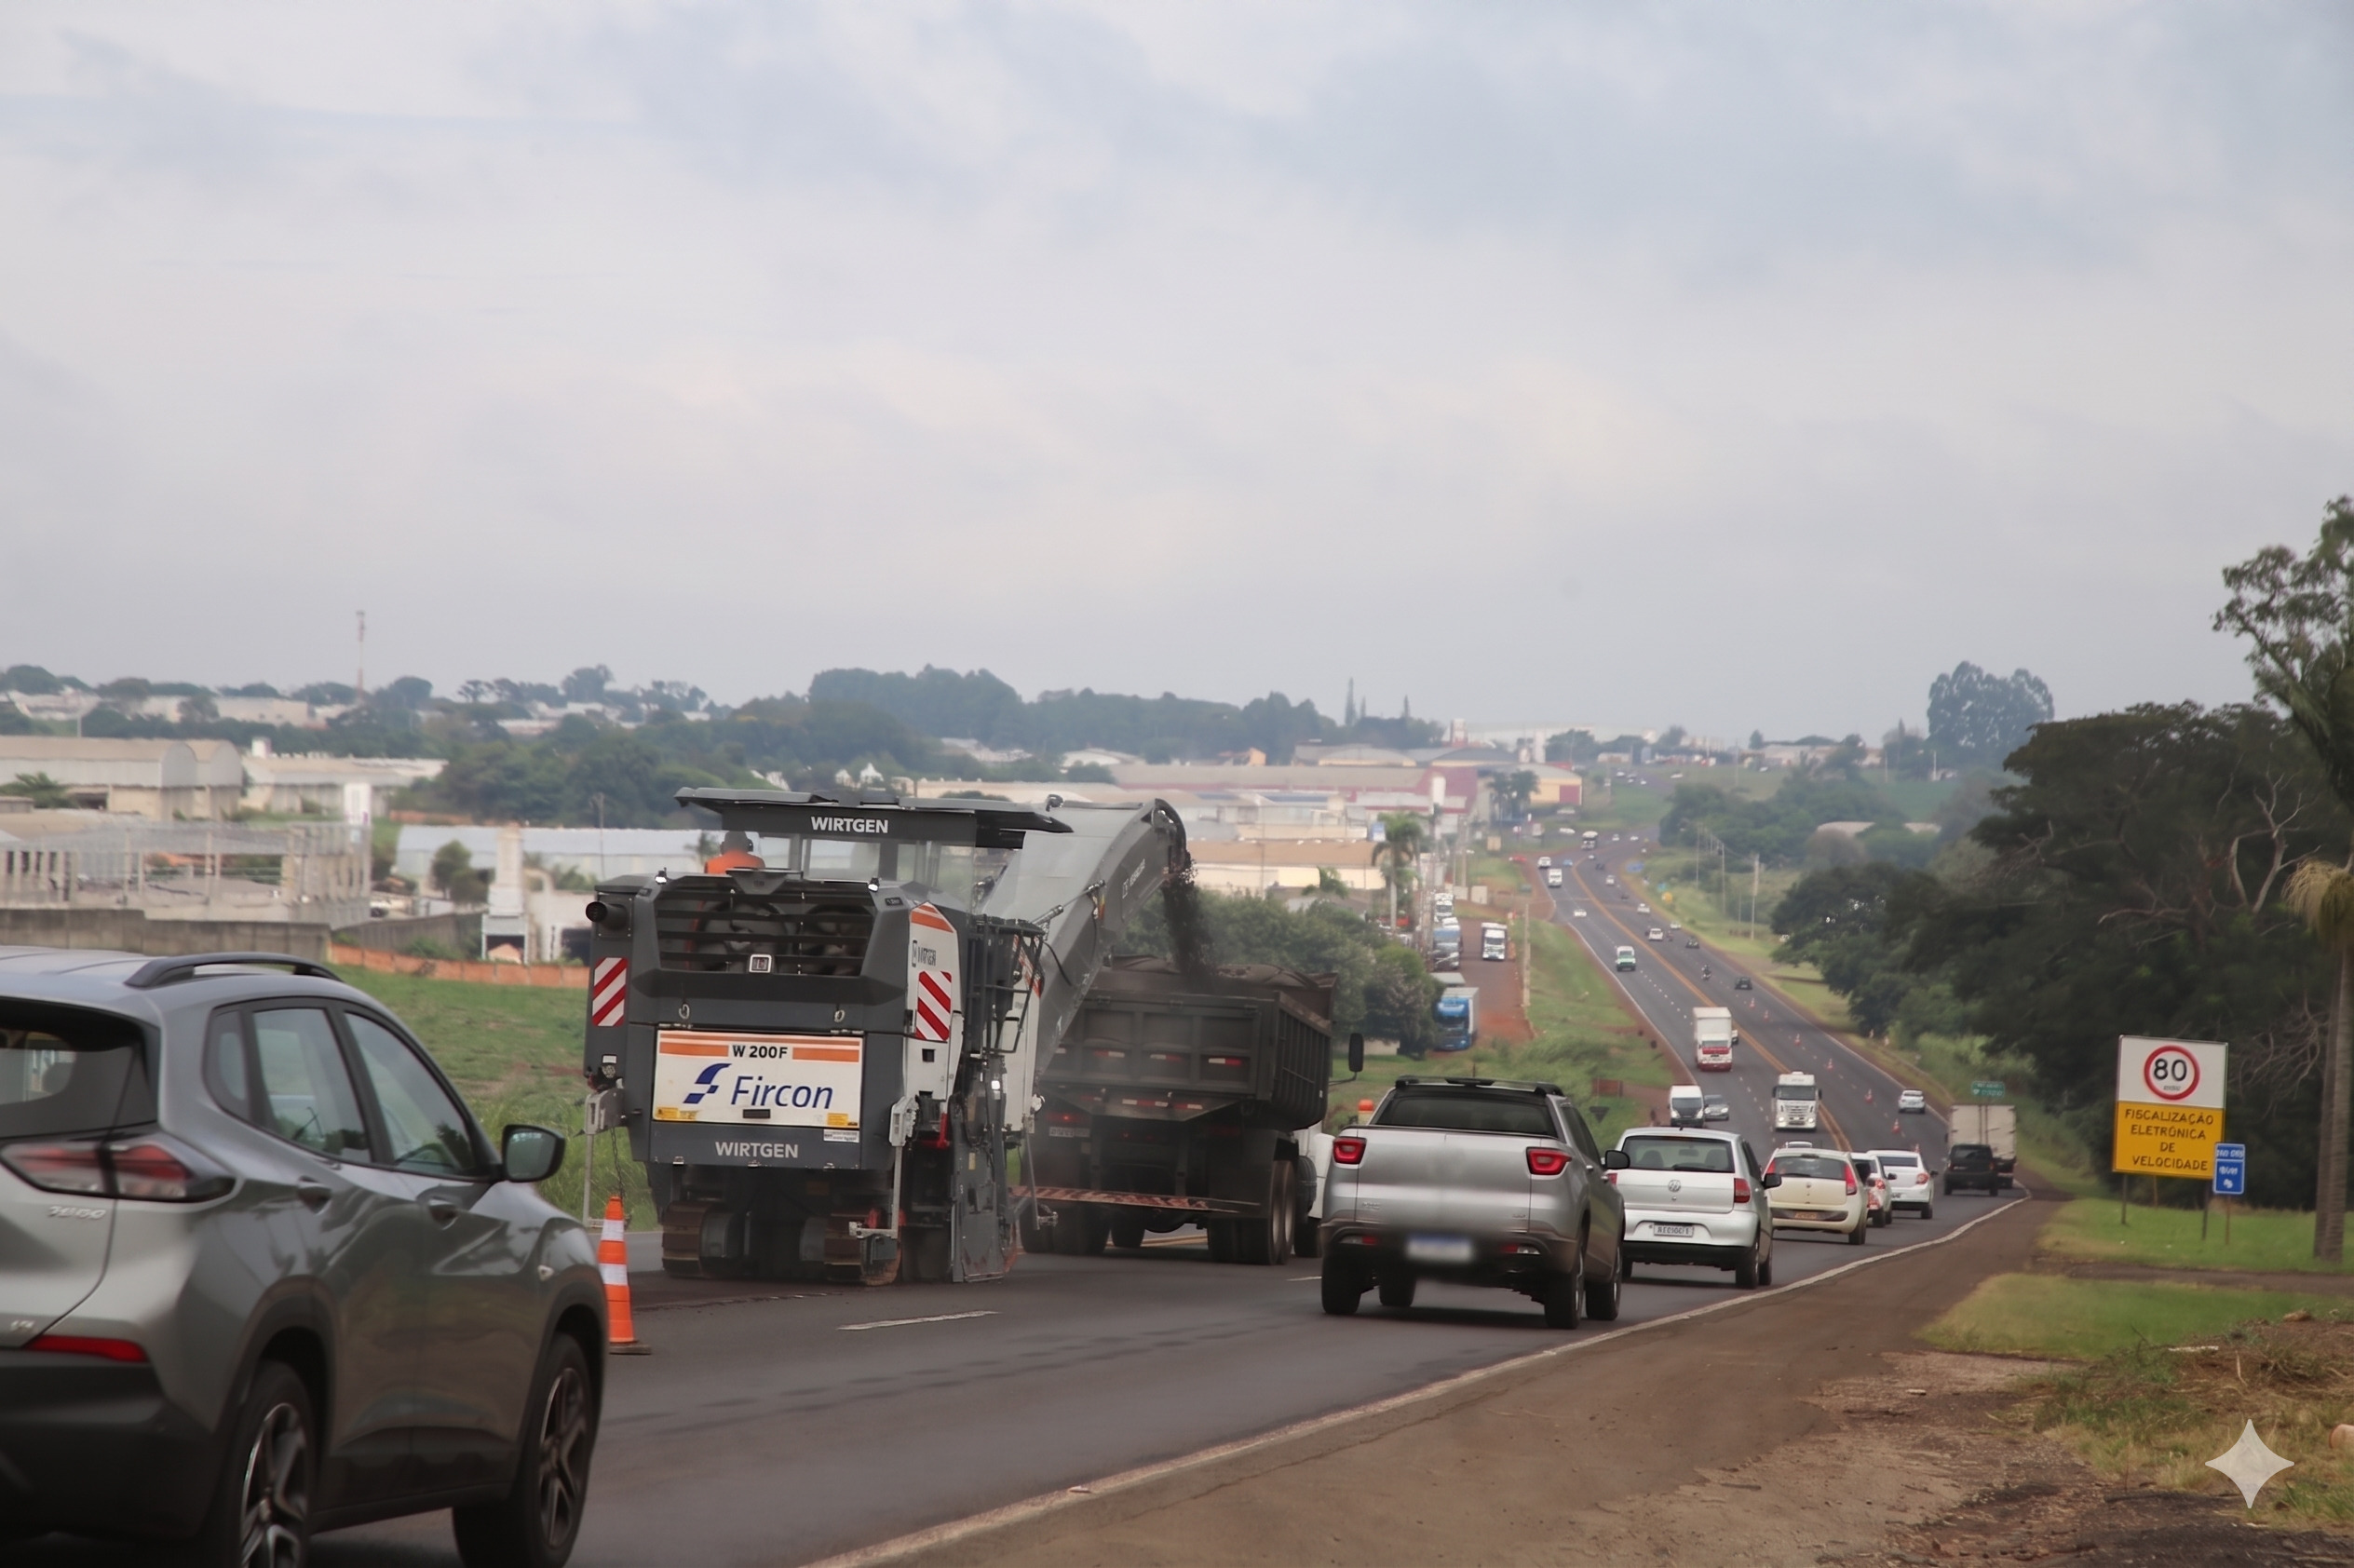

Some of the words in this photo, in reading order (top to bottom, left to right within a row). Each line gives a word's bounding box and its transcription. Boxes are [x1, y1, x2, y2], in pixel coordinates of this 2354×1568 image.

[810, 816, 888, 833] WIRTGEN
[732, 1045, 746, 1058] W
[749, 1046, 788, 1059] 200F
[2153, 1058, 2187, 1081] 80
[731, 1075, 833, 1109] Fircon
[715, 1142, 798, 1158] WIRTGEN
[2159, 1142, 2175, 1153] DE
[2131, 1156, 2208, 1170] VELOCIDADE
